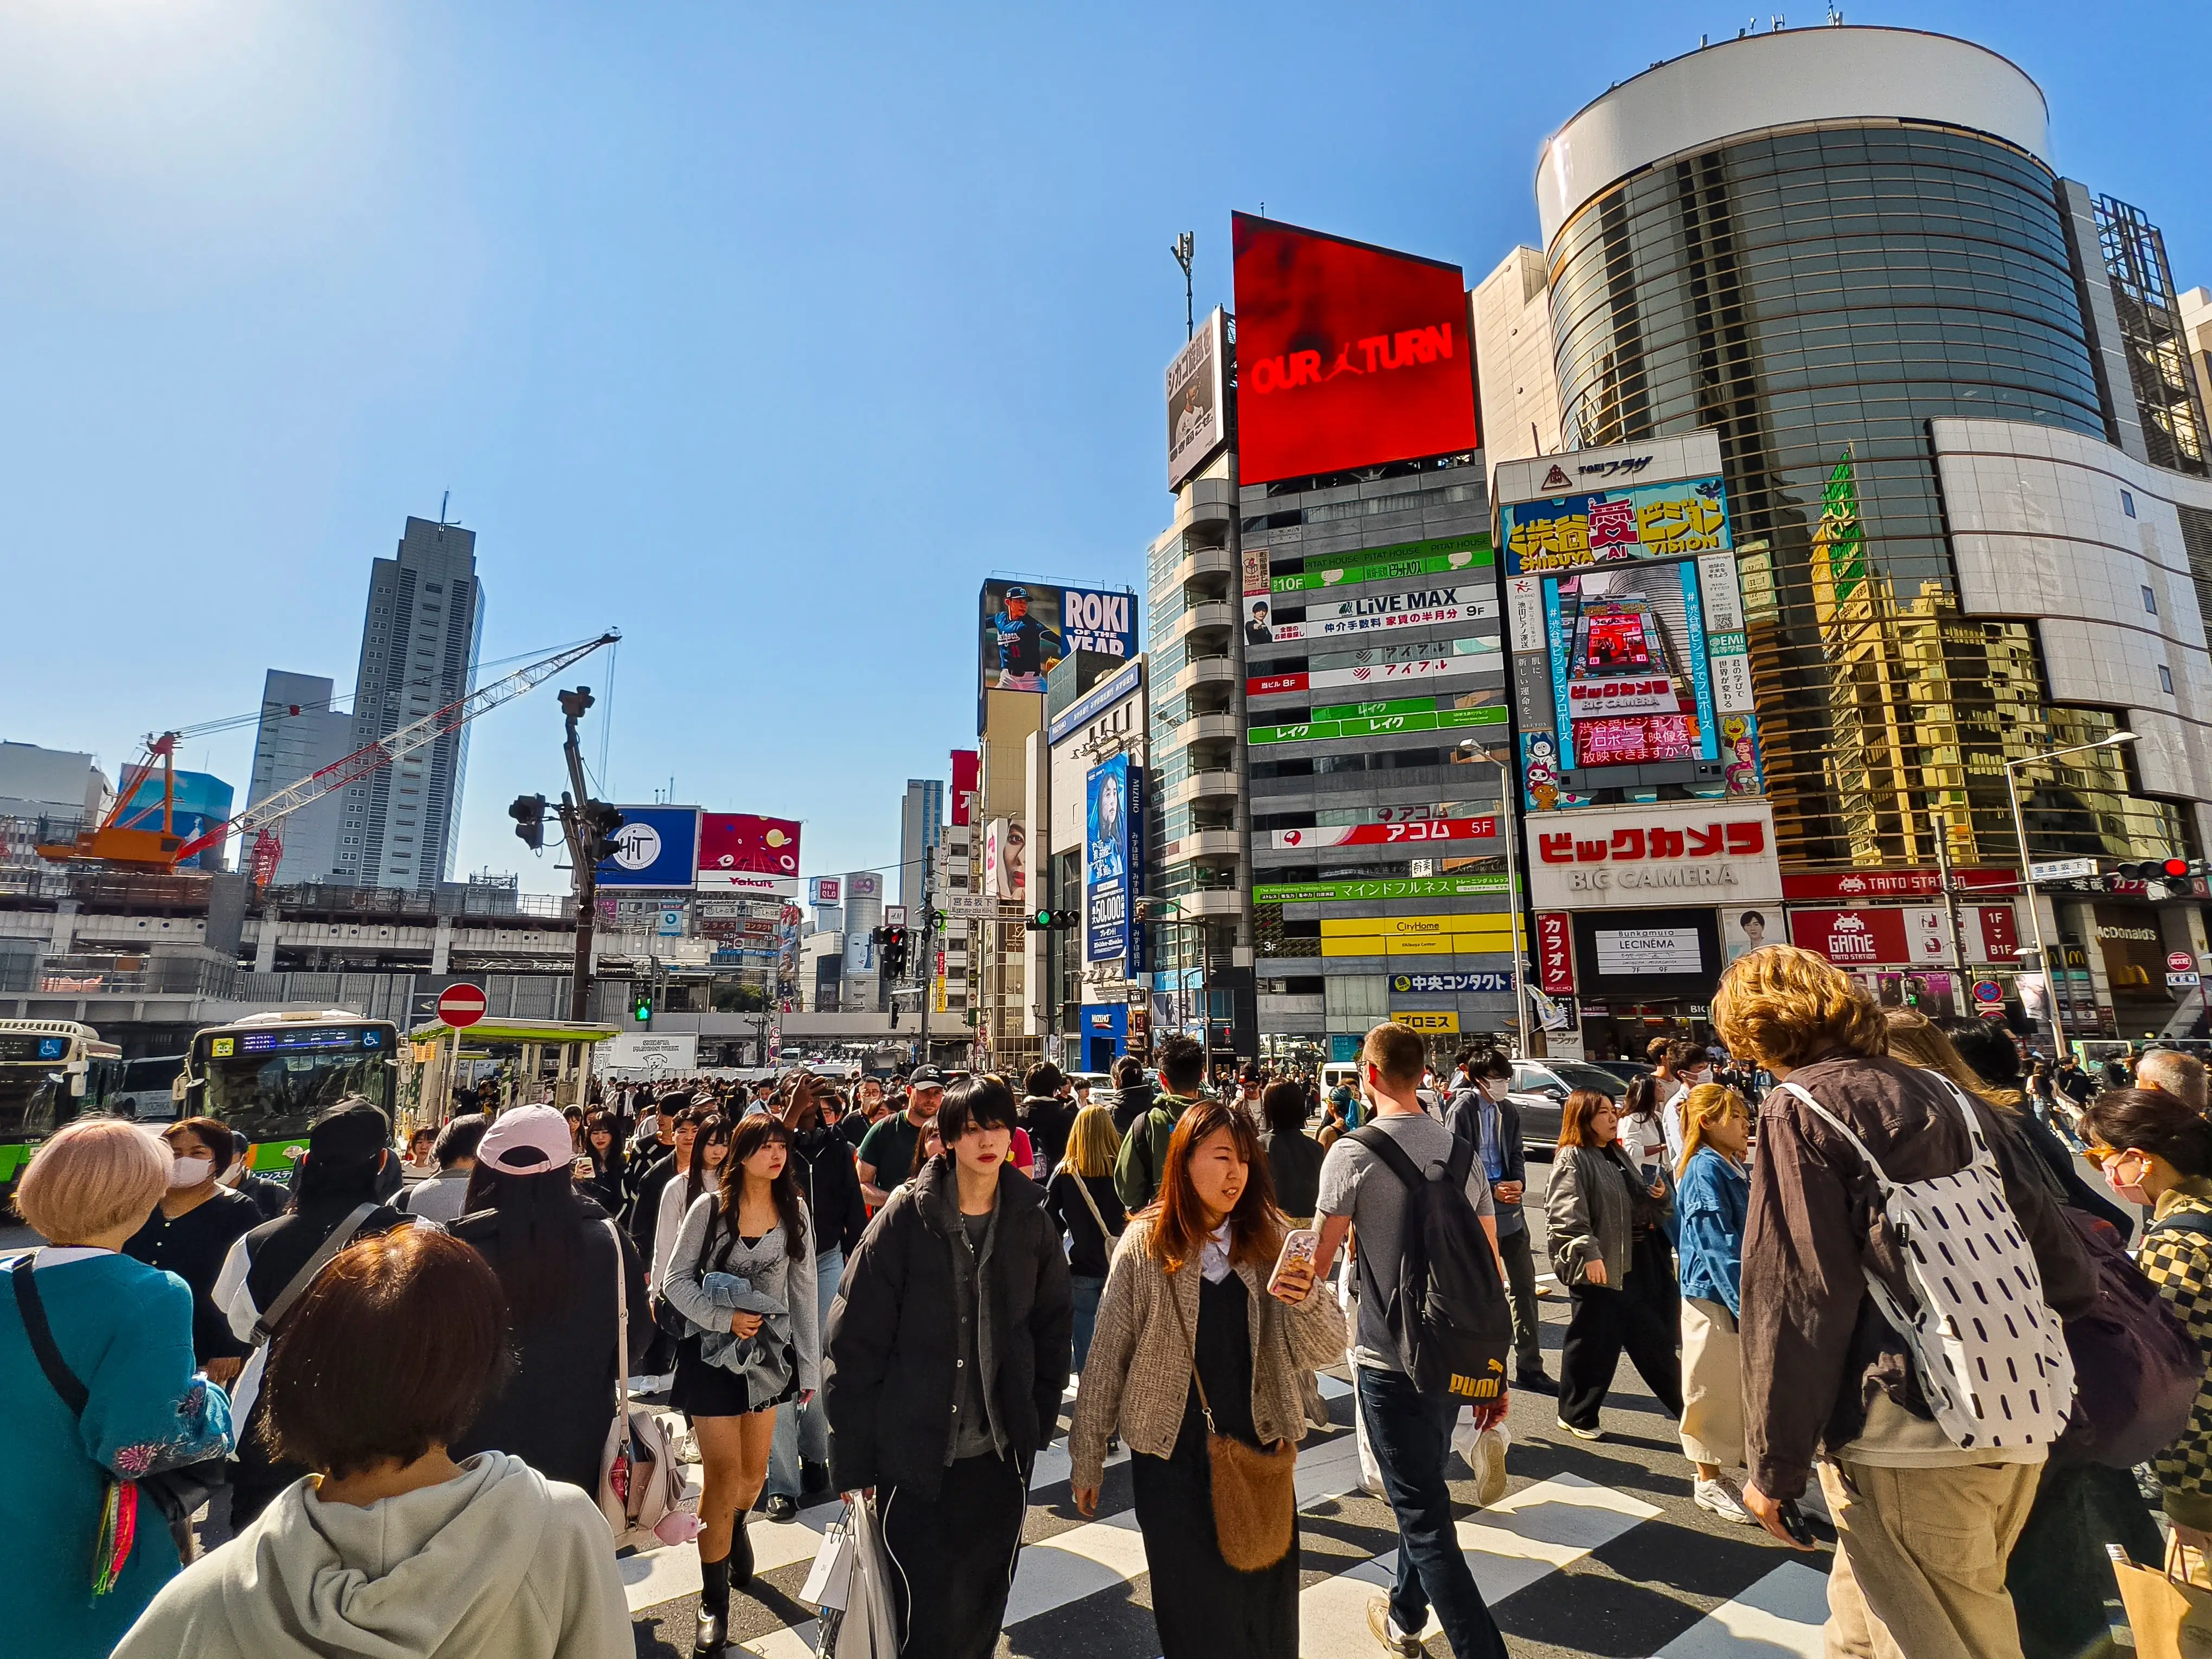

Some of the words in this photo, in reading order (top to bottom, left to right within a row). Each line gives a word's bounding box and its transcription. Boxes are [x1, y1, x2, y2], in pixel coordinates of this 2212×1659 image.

[1251, 350, 1322, 394] OUR
[1358, 323, 1453, 372] TURN
[1431, 543, 1455, 551] PITAT
[1457, 538, 1489, 548] HOUSE
[1305, 560, 1327, 569] PITAT
[1329, 555, 1358, 565] HOUSE
[1364, 552, 1387, 561] PITAT
[1389, 547, 1420, 558] HOUSE
[1519, 550, 1596, 573] SHIBUYA
[1607, 545, 1628, 560] AI
[1647, 535, 1721, 556] VISION
[1278, 577, 1303, 591] 10F
[1356, 595, 1401, 615] LiVE
[1407, 588, 1458, 609] MAX
[1066, 591, 1129, 633] ROKI
[1324, 618, 1381, 633] 仲介手数料
[1385, 608, 1458, 626] 家賃の半月分
[1466, 606, 1485, 616] 9F
[1066, 634, 1125, 657] YEAR
[1721, 636, 1744, 646] EMI
[1385, 660, 1448, 676] アイフル
[1532, 657, 1543, 679] 肌に、
[1719, 660, 1732, 708] 世界が変わる
[1732, 659, 1745, 697] 君の学びで
[1518, 658, 1533, 719] 新しい運命を。
[1606, 697, 1660, 709] CAMERA
[1369, 716, 1404, 730] レイク
[1276, 725, 1309, 739] レイク
[1387, 822, 1449, 841] アコム
[1471, 821, 1491, 834] 5F
[1539, 822, 1765, 863] ビックカメラ
[729, 877, 774, 889] Yakult
[1570, 869, 1611, 890] BIC
[1618, 864, 1738, 888] CAMERA
[1868, 877, 1907, 889] TAITO
[1342, 880, 1450, 897] マインドフルネス
[953, 897, 993, 906] 宮益坂下
[1096, 895, 1121, 924] 50,000
[1988, 913, 2002, 923] 1F
[1264, 942, 1277, 951] 3F
[1545, 919, 1566, 982] カラオケ
[1828, 934, 1875, 953] GAME
[1990, 945, 2012, 954] B1F
[1412, 974, 1506, 991] 中央コンタクト
[1399, 1015, 1449, 1028] プロミス
